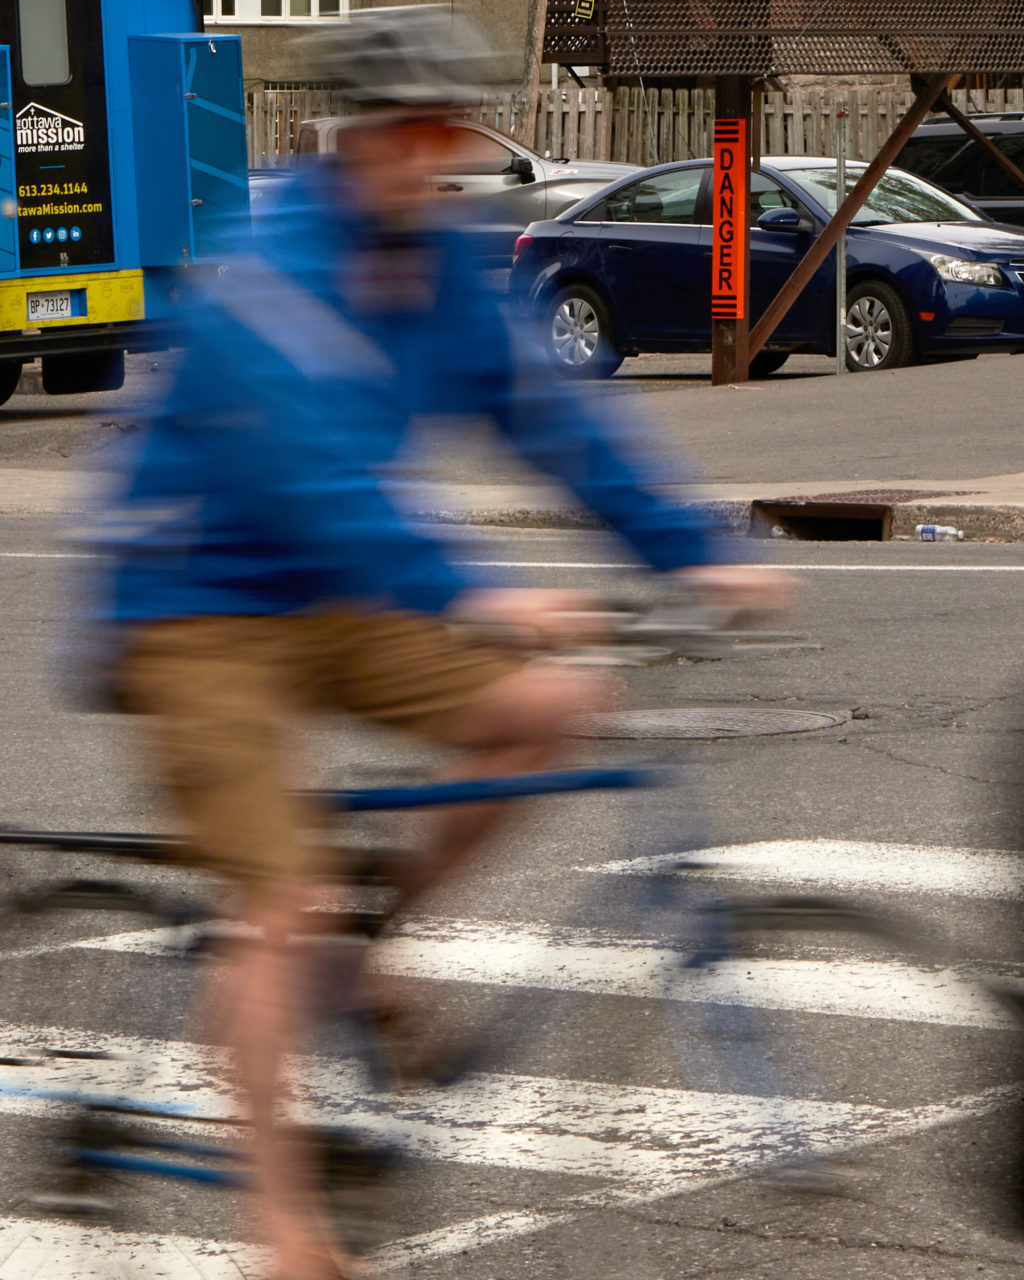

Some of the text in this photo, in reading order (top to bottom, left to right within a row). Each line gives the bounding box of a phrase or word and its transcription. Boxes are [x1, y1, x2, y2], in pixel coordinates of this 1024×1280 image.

[21, 115, 62, 130] ottawa
[16, 126, 85, 145] mission
[38, 144, 53, 152] than
[60, 143, 84, 151] shelter
[18, 182, 88, 197] 613.234.1144
[18, 202, 103, 216] tawaMission.com
[719, 149, 734, 290] DANGER
